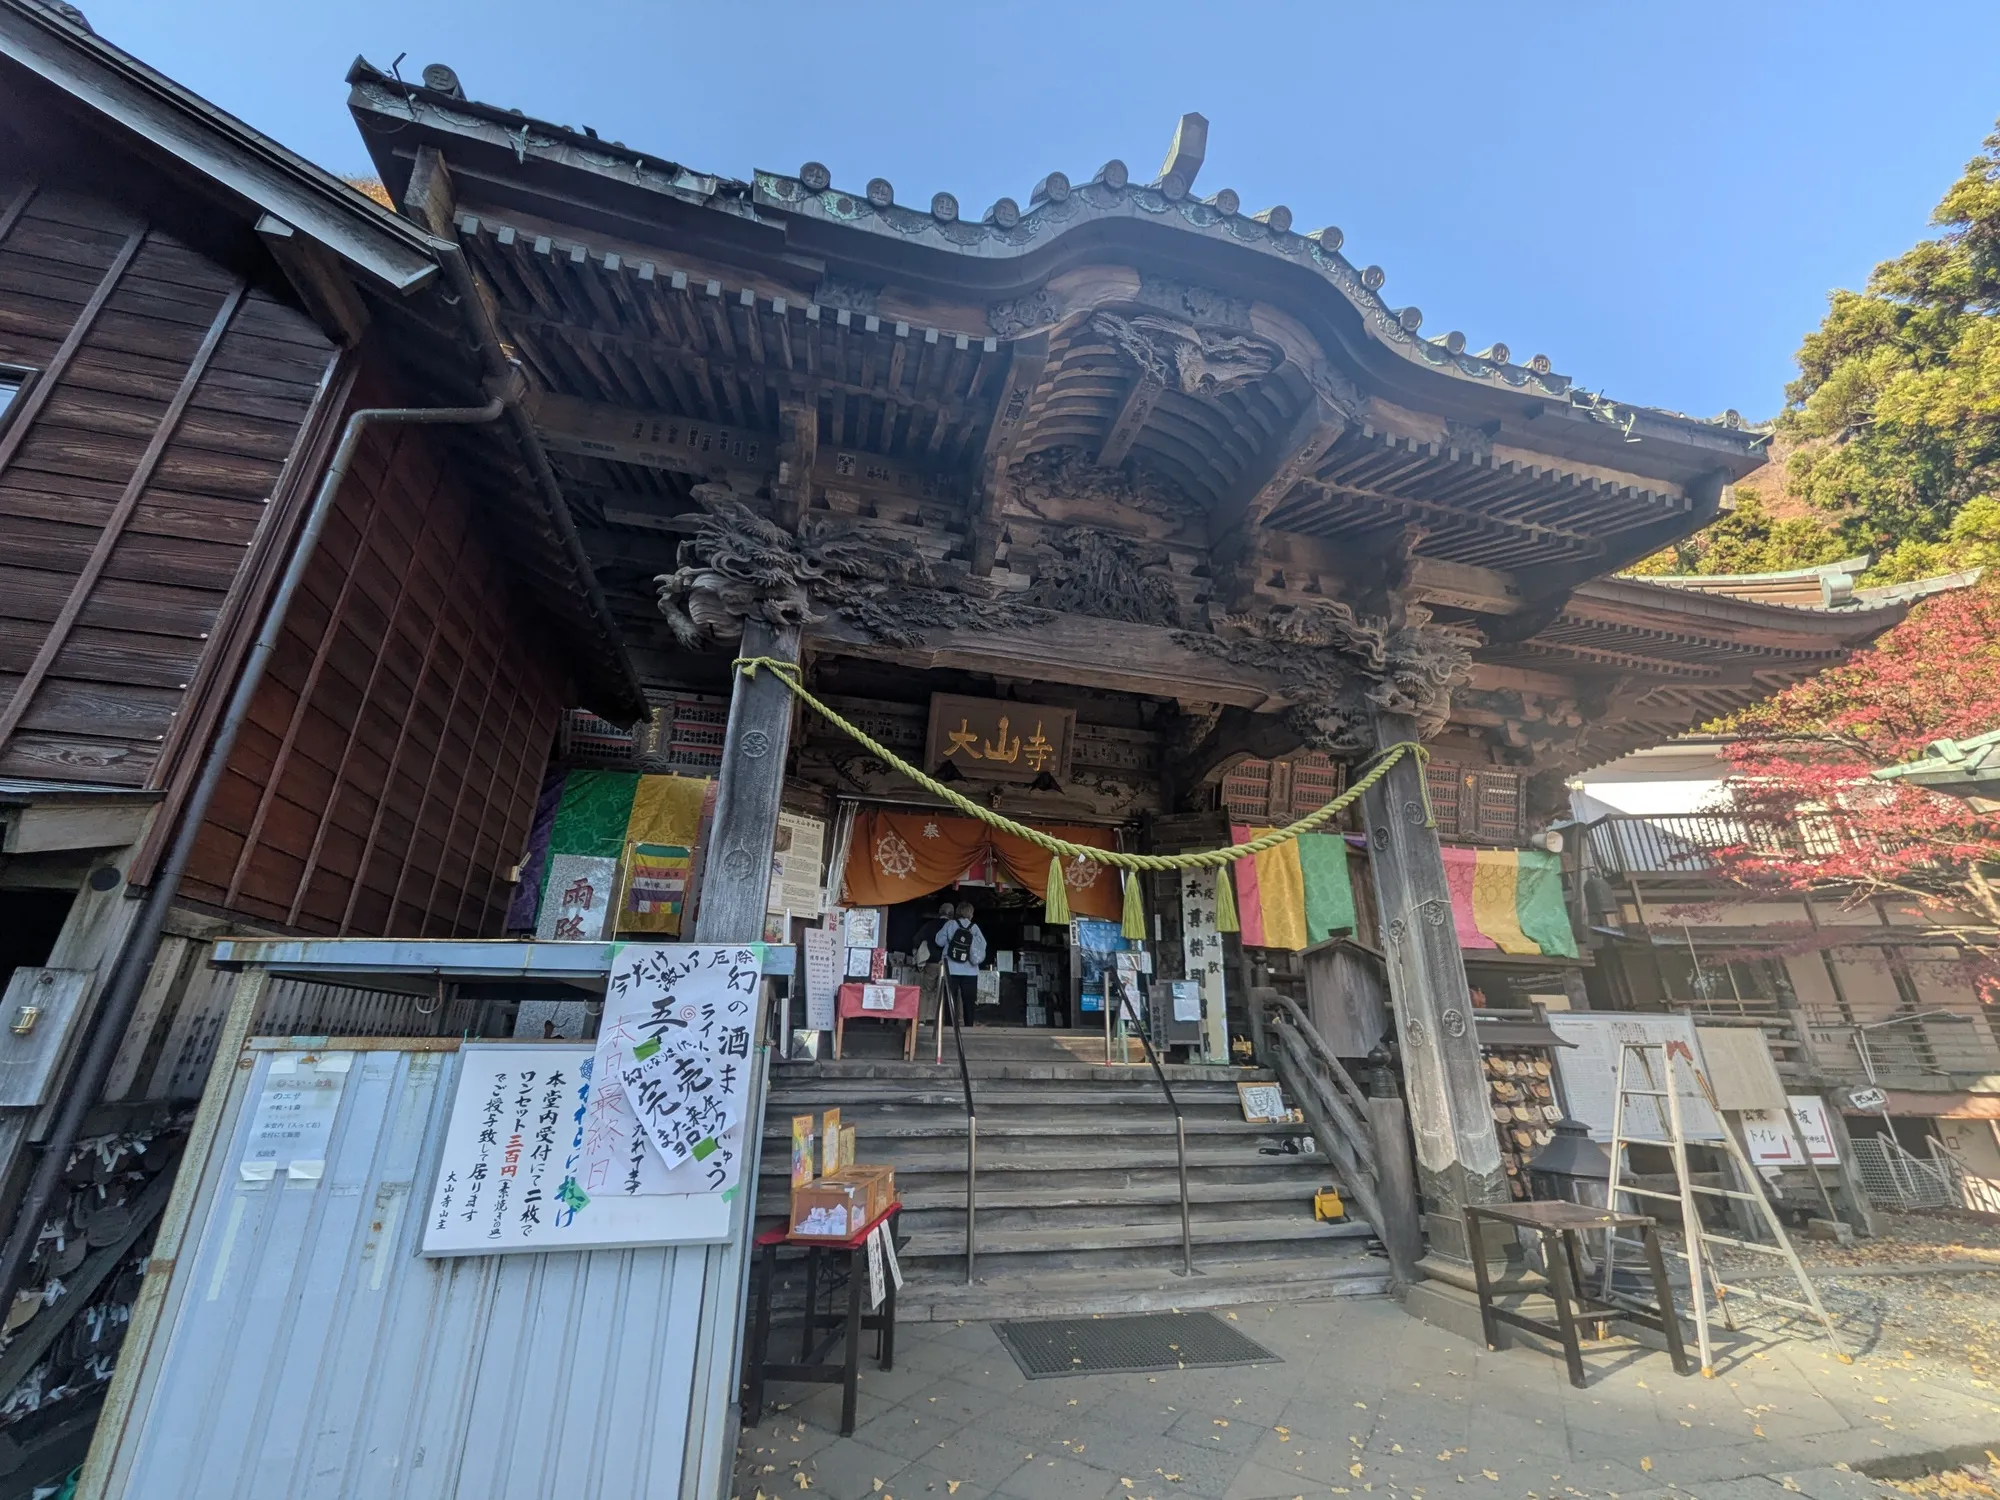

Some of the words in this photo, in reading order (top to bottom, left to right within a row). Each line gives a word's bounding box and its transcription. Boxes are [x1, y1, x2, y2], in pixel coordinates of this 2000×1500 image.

[942, 715, 1053, 771] 大山寺
[922, 822, 940, 840] 奉
[707, 949, 755, 968] 厄除
[638, 1057, 713, 1127] 完売
[707, 965, 757, 1190] 幻の酒まじゅう
[519, 1070, 566, 1237] 本堂内受付にて二枚で
[1750, 1129, 1776, 1142] トイレ
[436, 1171, 458, 1230] 大山寺山主
